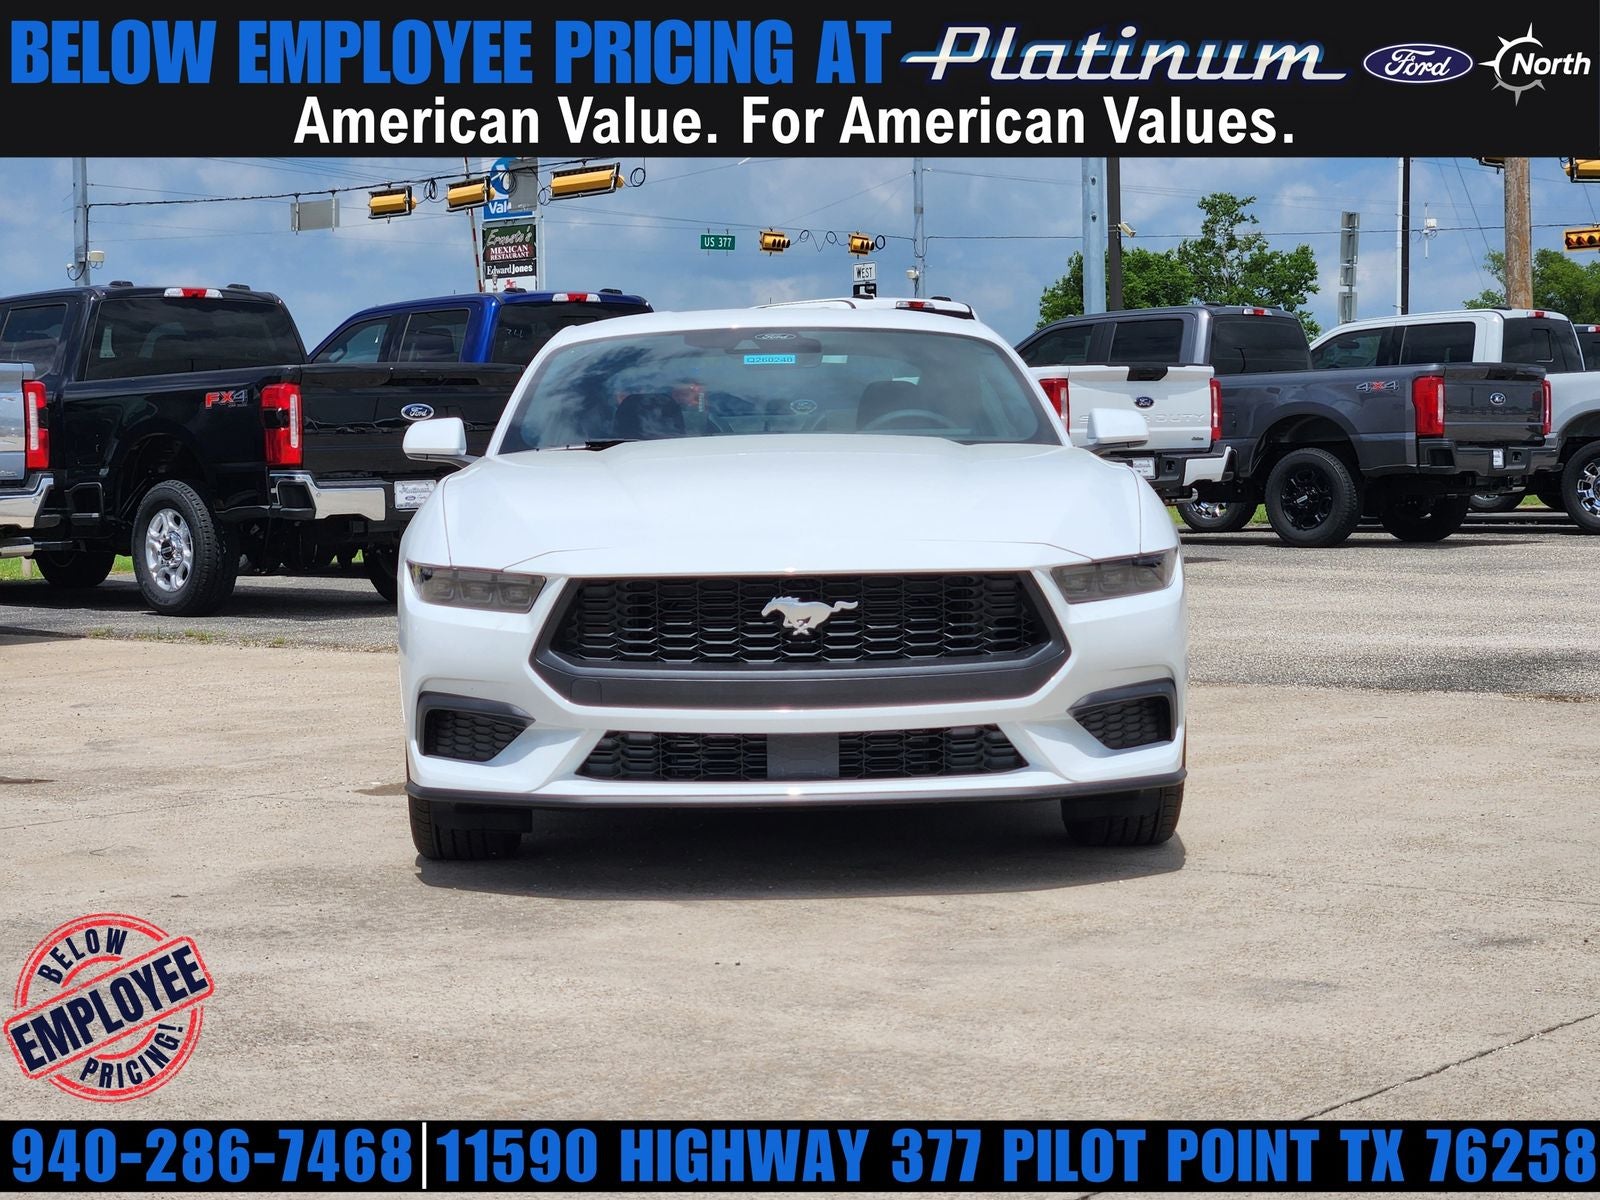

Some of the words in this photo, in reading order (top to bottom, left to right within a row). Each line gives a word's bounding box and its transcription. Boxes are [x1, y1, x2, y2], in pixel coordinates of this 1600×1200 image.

[488, 200, 511, 215] Val
[704, 237, 715, 247] US
[718, 237, 732, 248] 377
[490, 244, 529, 255] MEXICAN
[490, 251, 530, 261] RESTAURANT
[856, 266, 872, 279] WEST
[204, 389, 248, 409] FX4
